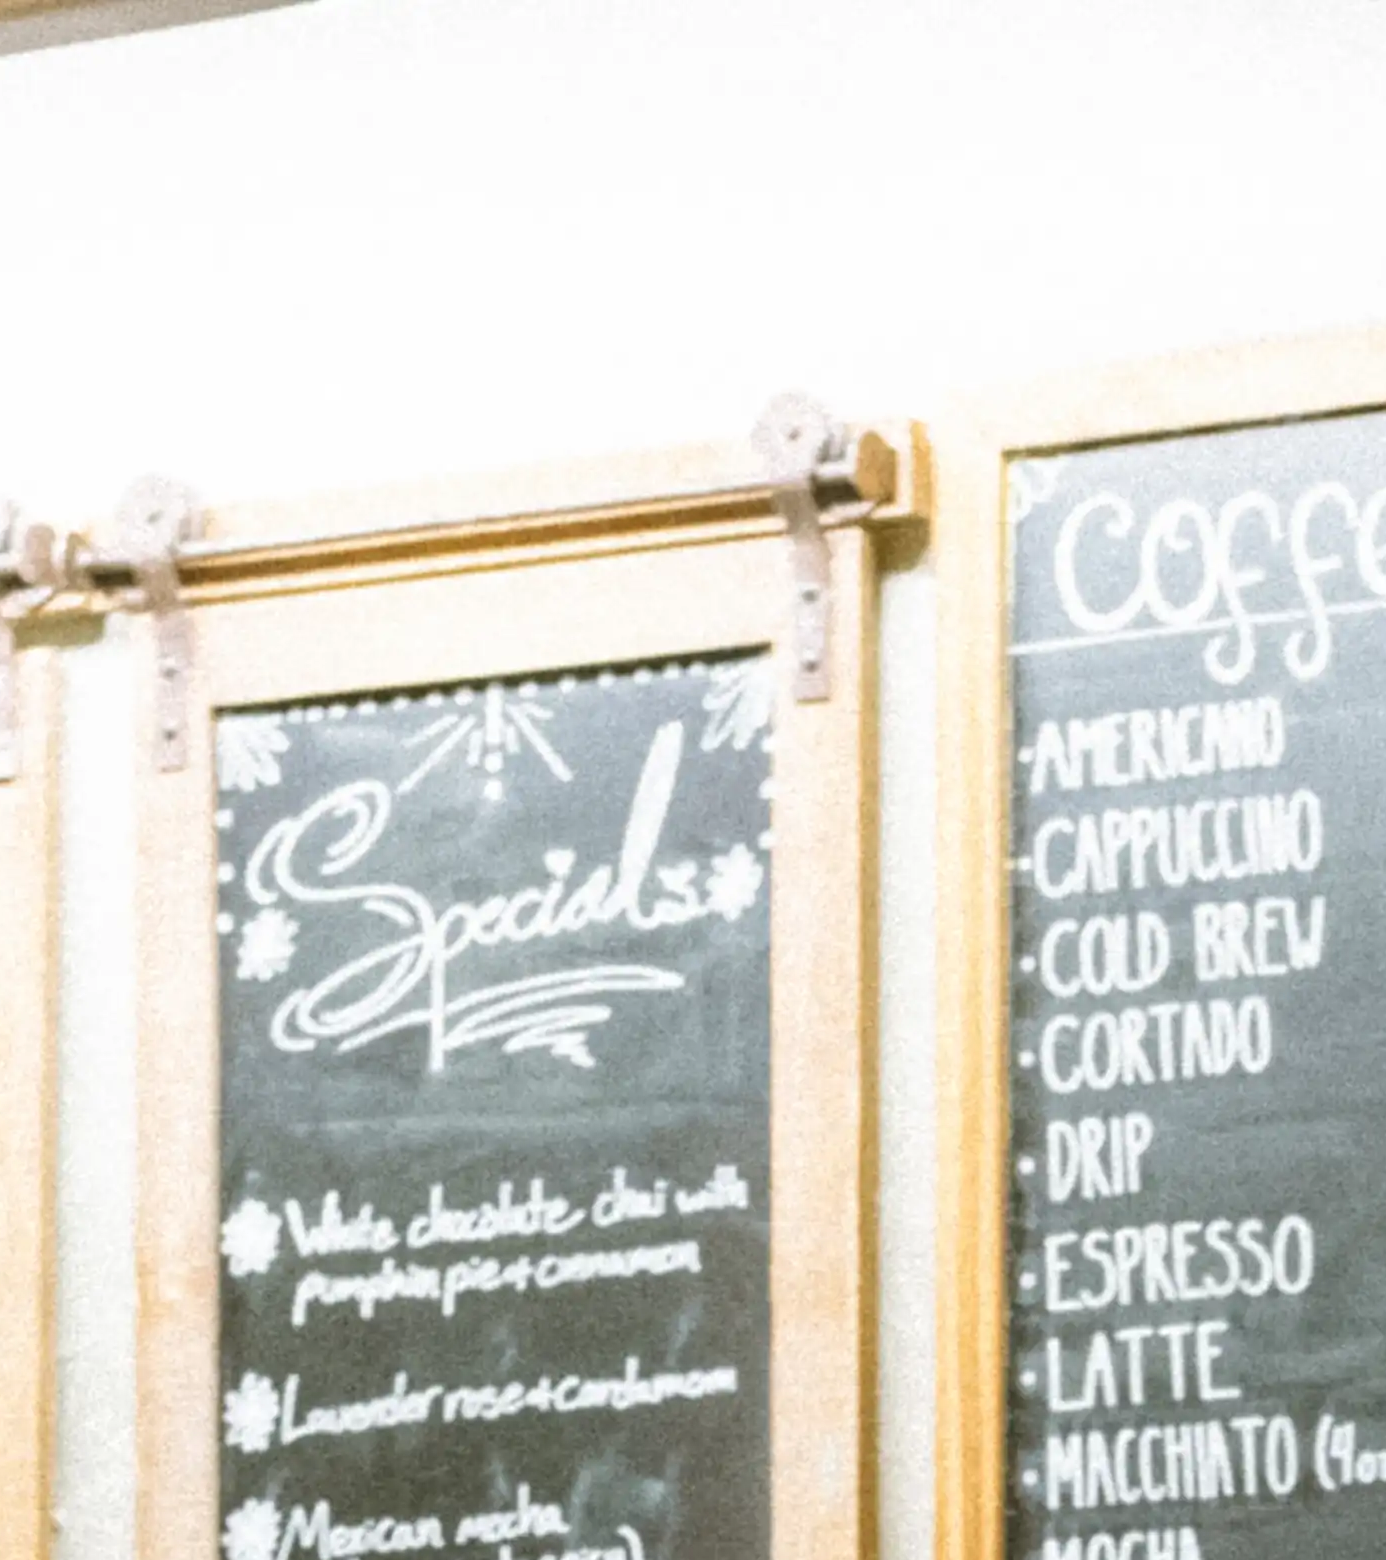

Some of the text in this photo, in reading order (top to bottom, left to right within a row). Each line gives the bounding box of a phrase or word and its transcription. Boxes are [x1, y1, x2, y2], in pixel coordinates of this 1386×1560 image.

[1028, 696, 1286, 794] AMERICANO
[1033, 789, 1323, 899] CAPPUCCINO
[1039, 896, 1325, 998] COLD BREW
[1040, 995, 1272, 1094] CORTADO
[1047, 1112, 1153, 1203] DRIP
[284, 1190, 399, 1257] White
[407, 1179, 585, 1247] chocolate
[1044, 1213, 1314, 1312] ESPRESSO
[292, 1258, 441, 1326] pumpkin
[536, 1241, 702, 1288] cinnamon
[281, 1371, 442, 1444] Lavender
[1047, 1320, 1242, 1412] LATTE
[1046, 1415, 1298, 1510] MACCHIATO
[456, 1482, 570, 1544] mocha
